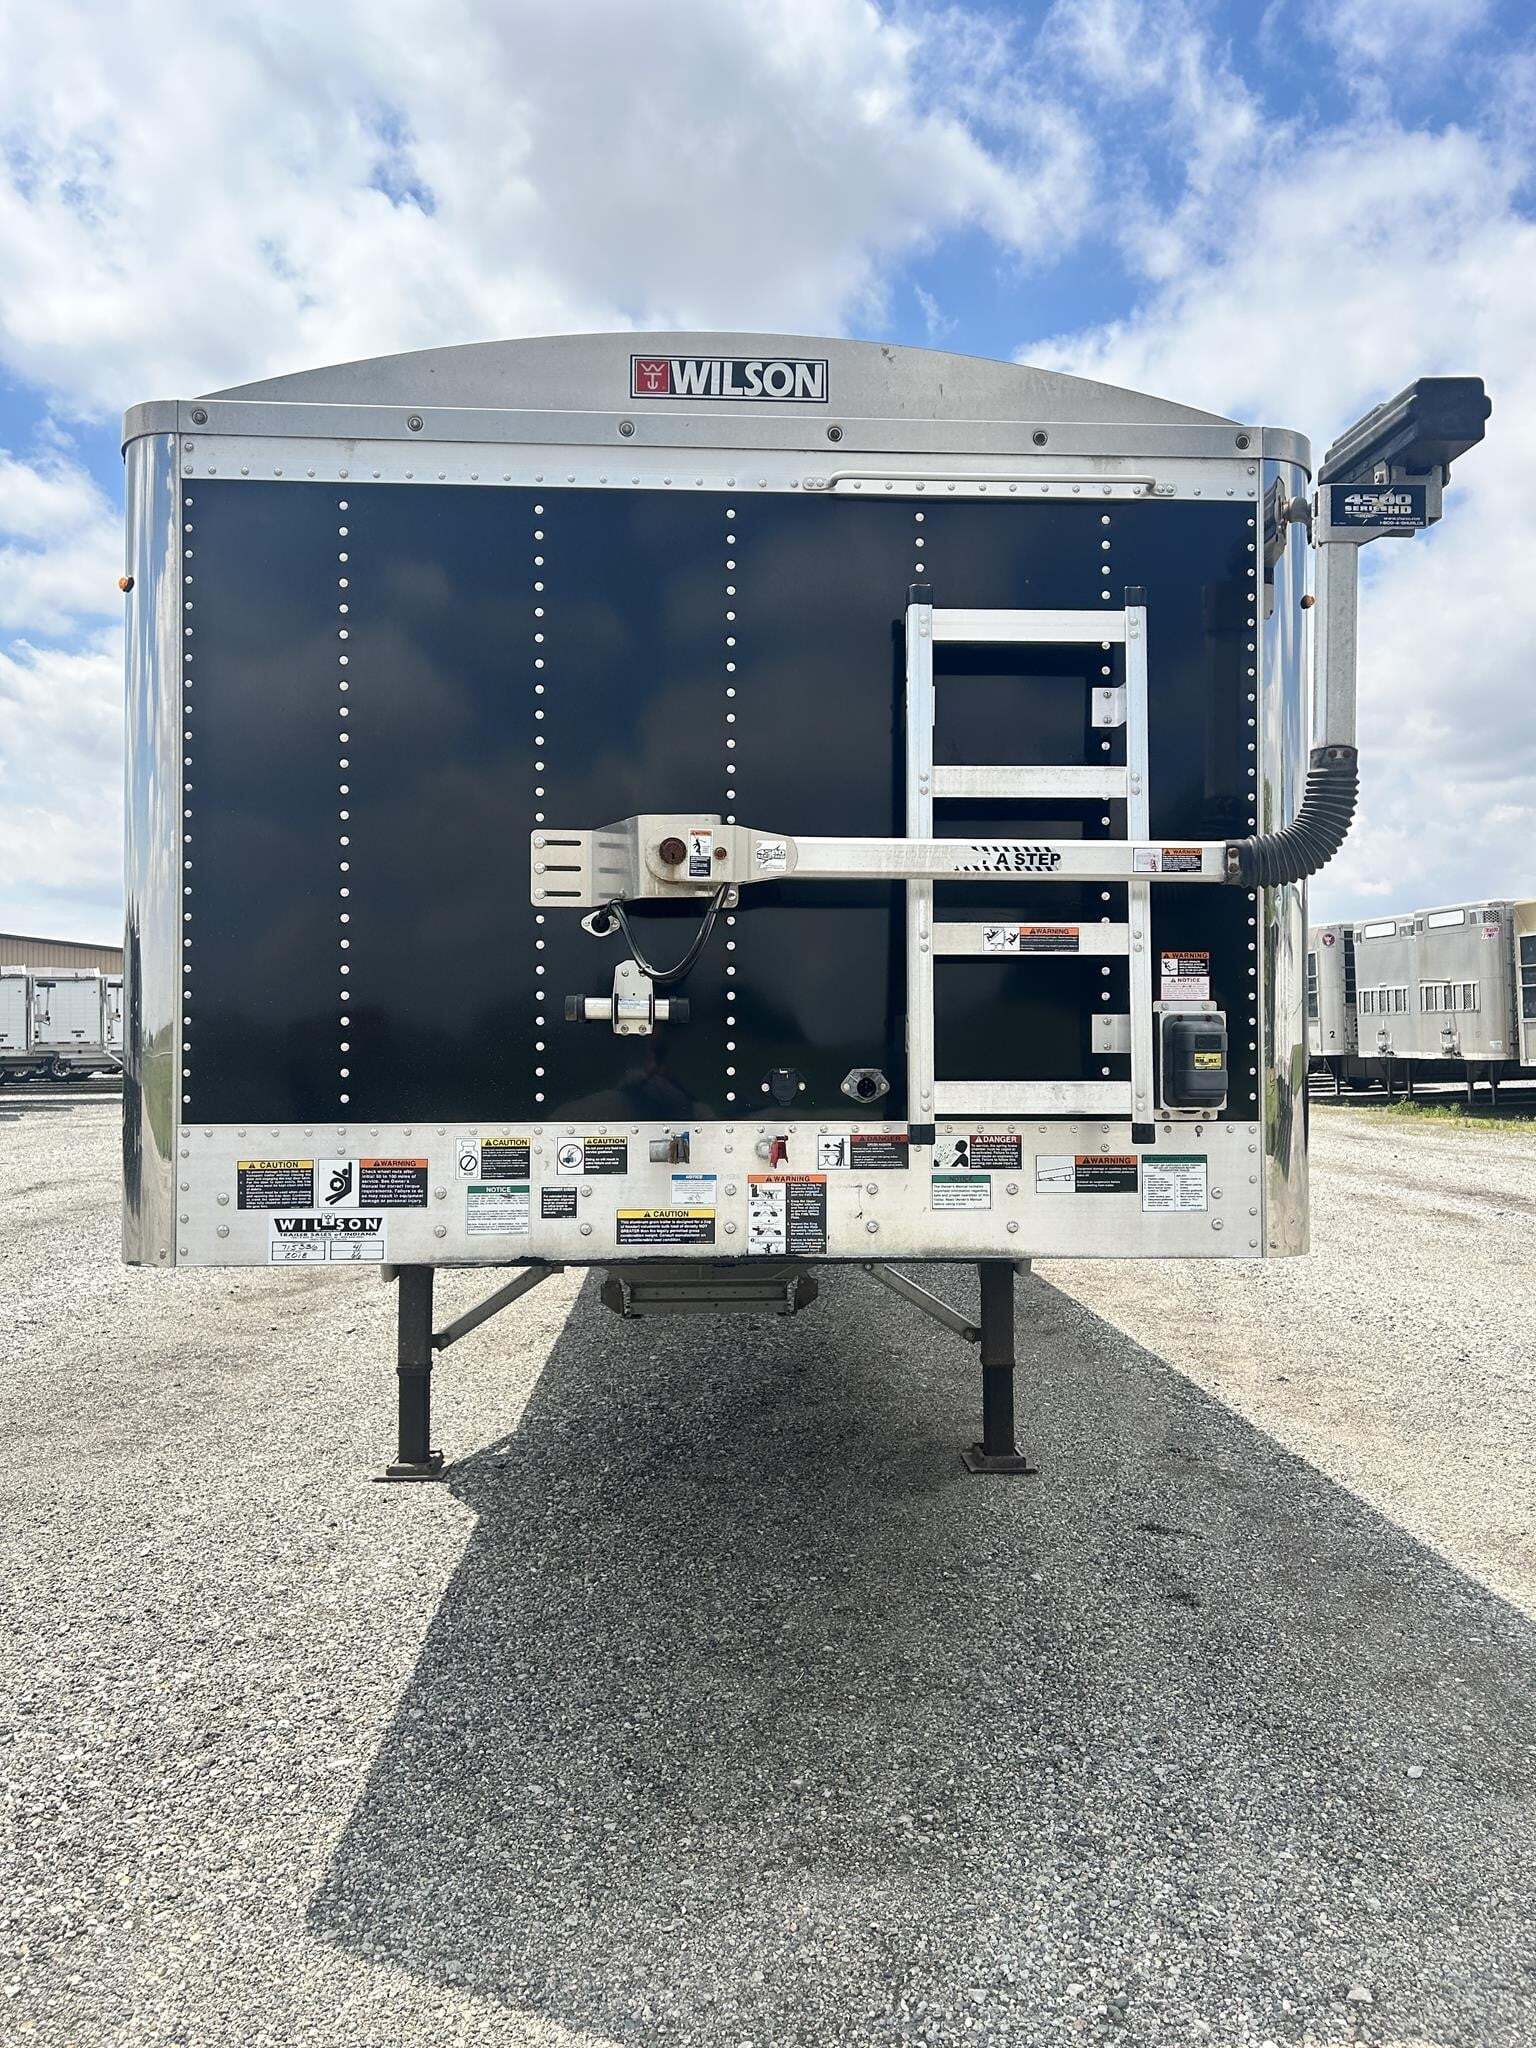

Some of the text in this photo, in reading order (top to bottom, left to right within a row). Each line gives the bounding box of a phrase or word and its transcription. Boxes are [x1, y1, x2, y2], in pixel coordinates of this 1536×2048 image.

[671, 360, 822, 397] WILSON
[1344, 494, 1411, 504] 4500
[996, 853, 1061, 865] A STEP
[279, 1219, 377, 1230] WILSON
